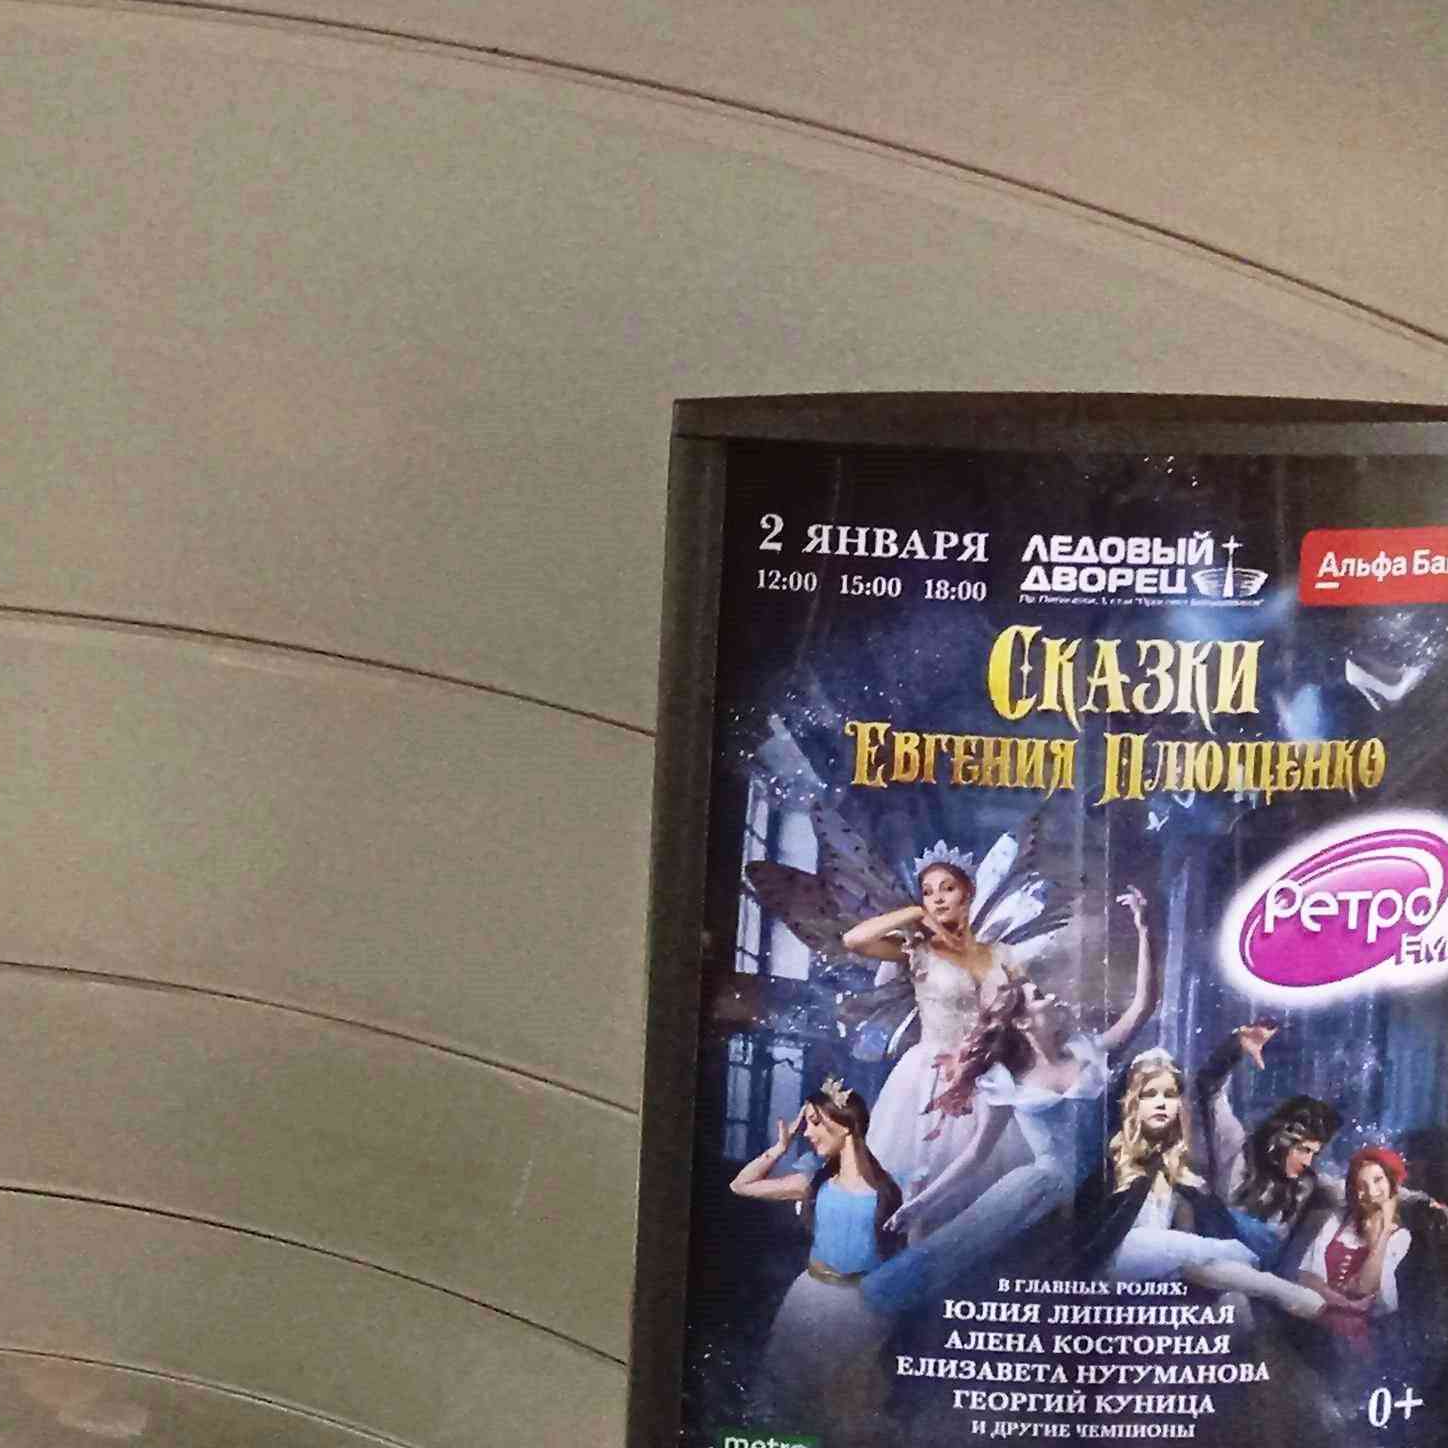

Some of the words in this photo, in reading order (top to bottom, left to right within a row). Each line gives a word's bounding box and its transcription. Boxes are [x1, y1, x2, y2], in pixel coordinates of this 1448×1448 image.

[759, 513, 784, 552] 2
[801, 523, 990, 563] ЯНВАРЯ
[1021, 530, 1215, 565] ЛЕДОВЫЙ
[1020, 565, 1188, 594] ДВОРЕЦ
[1316, 550, 1407, 584] Альфа
[757, 569, 818, 592] 12:00
[839, 574, 902, 598] 15:00
[924, 578, 987, 602] 18:00
[997, 1277, 1011, 1293] В
[1014, 1278, 1111, 1295] ГЛАВНЫХ
[1116, 1280, 1189, 1296] РОЛЯХ:
[942, 1298, 1041, 1324] ЮЛИЯ
[1047, 1303, 1236, 1330] ЛИПНИЦКАЯ
[943, 1329, 1045, 1354] АЛЕНА
[1052, 1334, 1231, 1355] КОСТОРНАЯ
[895, 1355, 1069, 1384] ЕЛИЗАВЕТА
[1075, 1361, 1271, 1385] НУГУМАНОВА
[952, 1389, 1087, 1414] ГЕОРГИЙ
[1095, 1393, 1216, 1419] КУНИЦА
[1366, 1386, 1425, 1429] 0+
[970, 1419, 987, 1435] И
[989, 1420, 1072, 1439] ДРУГИЕ
[1075, 1423, 1196, 1439] ЧЕМПИОНЫ
